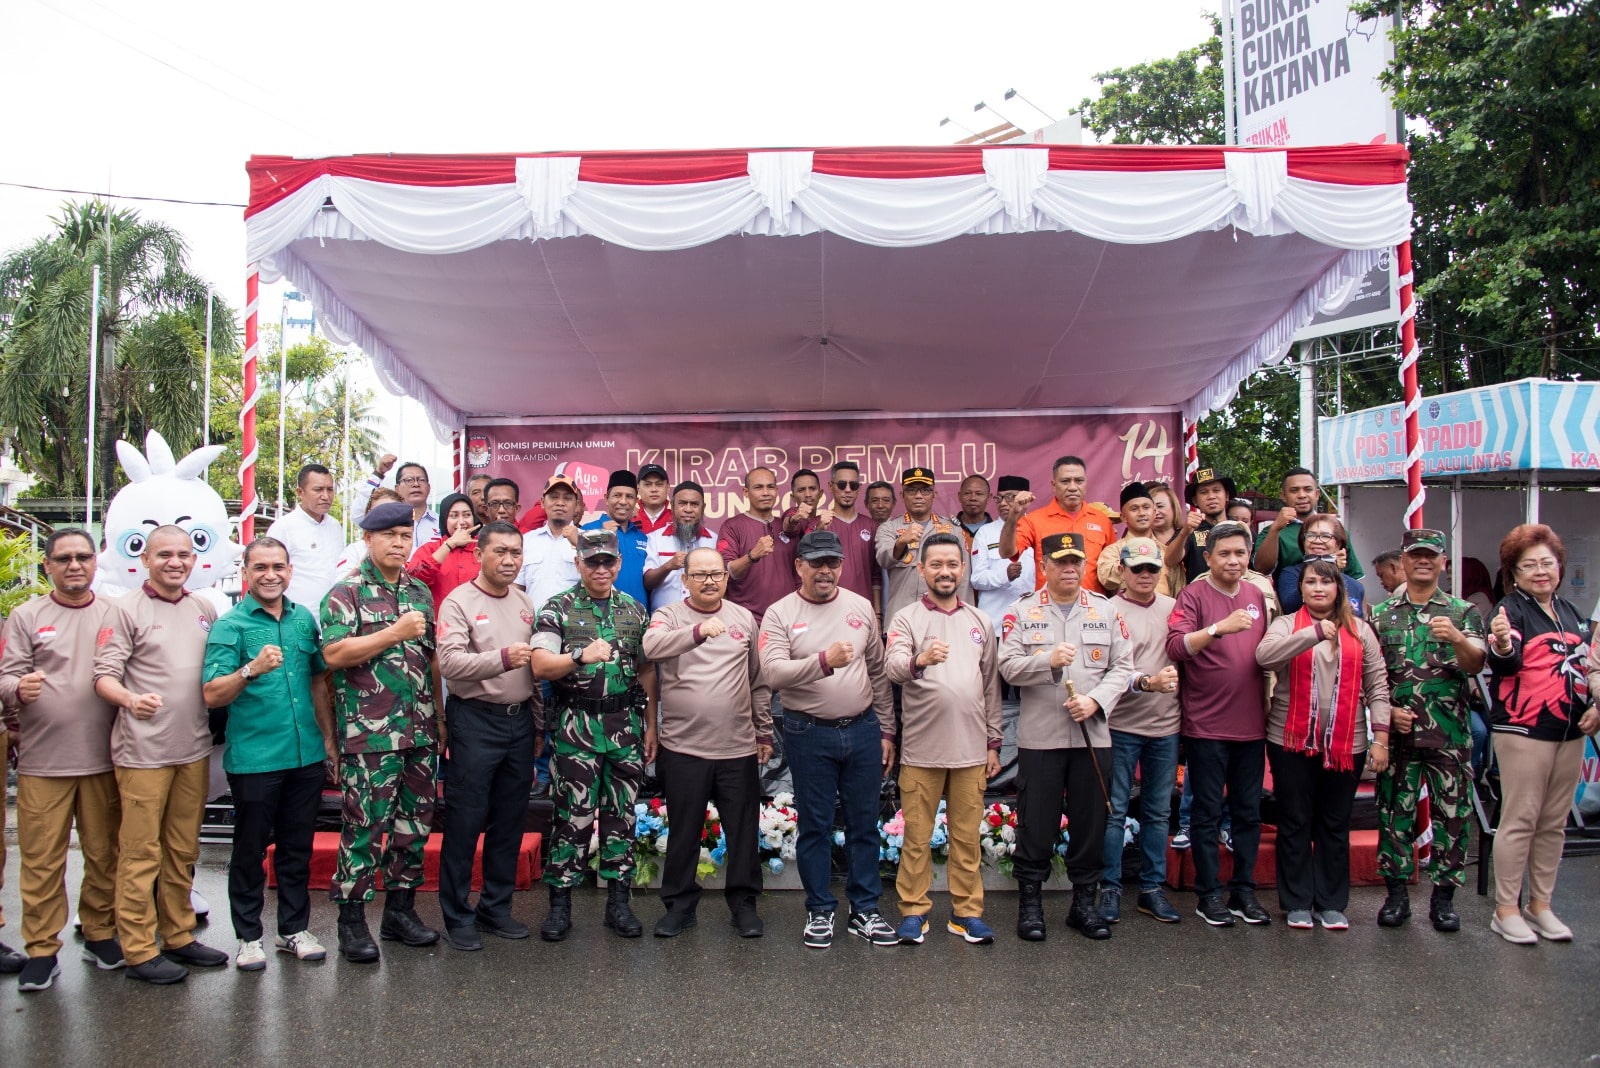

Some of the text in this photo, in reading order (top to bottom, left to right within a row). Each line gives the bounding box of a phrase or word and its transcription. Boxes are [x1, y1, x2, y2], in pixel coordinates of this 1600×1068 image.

[1241, 0, 1319, 40] BUKA
[1243, 14, 1311, 77] CUMA
[1244, 37, 1350, 116] KATANYA
[497, 440, 615, 450] KOMISI PEMILIHAN UMUM
[497, 453, 558, 462] KOTA AMBON
[1118, 419, 1174, 480] 14
[1355, 420, 1483, 459] POS TRPADU
[574, 466, 598, 488] Ayo
[626, 443, 997, 487] KIRAB PEMILU
[1335, 463, 1385, 480] KAWASAN
[1429, 456, 1461, 473] LALU
[1465, 451, 1512, 470] LINTAS
[1082, 622, 1107, 630] POLRI
